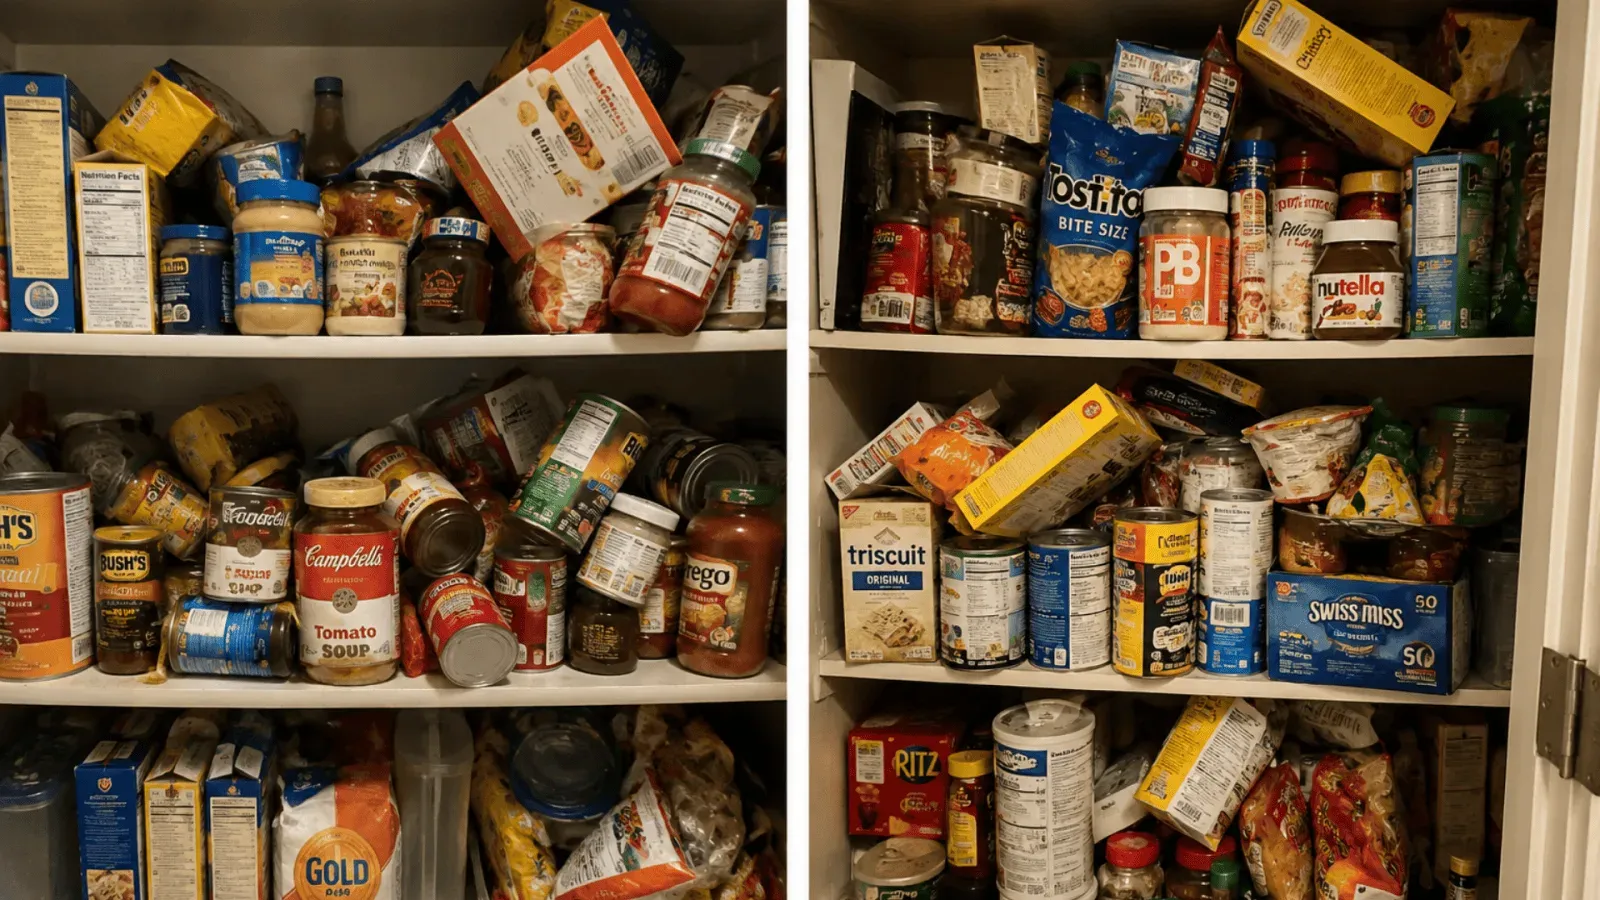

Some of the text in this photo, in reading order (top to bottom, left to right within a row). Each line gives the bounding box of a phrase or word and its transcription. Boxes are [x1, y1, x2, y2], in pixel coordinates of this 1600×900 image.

[1047, 162, 1146, 218] Tostito
[1058, 216, 1129, 240] BITE SIZE
[1154, 243, 1201, 299] PB
[1318, 274, 1385, 297] nutella
[101, 555, 147, 572] BUSH'S
[847, 544, 926, 565] triscuit
[866, 575, 910, 585] ORIGINAL
[1308, 600, 1359, 622] SWISS
[314, 625, 377, 640] Tomato
[322, 643, 370, 659] SOUP
[895, 749, 939, 779] RITZ
[305, 856, 369, 886] GOLD
